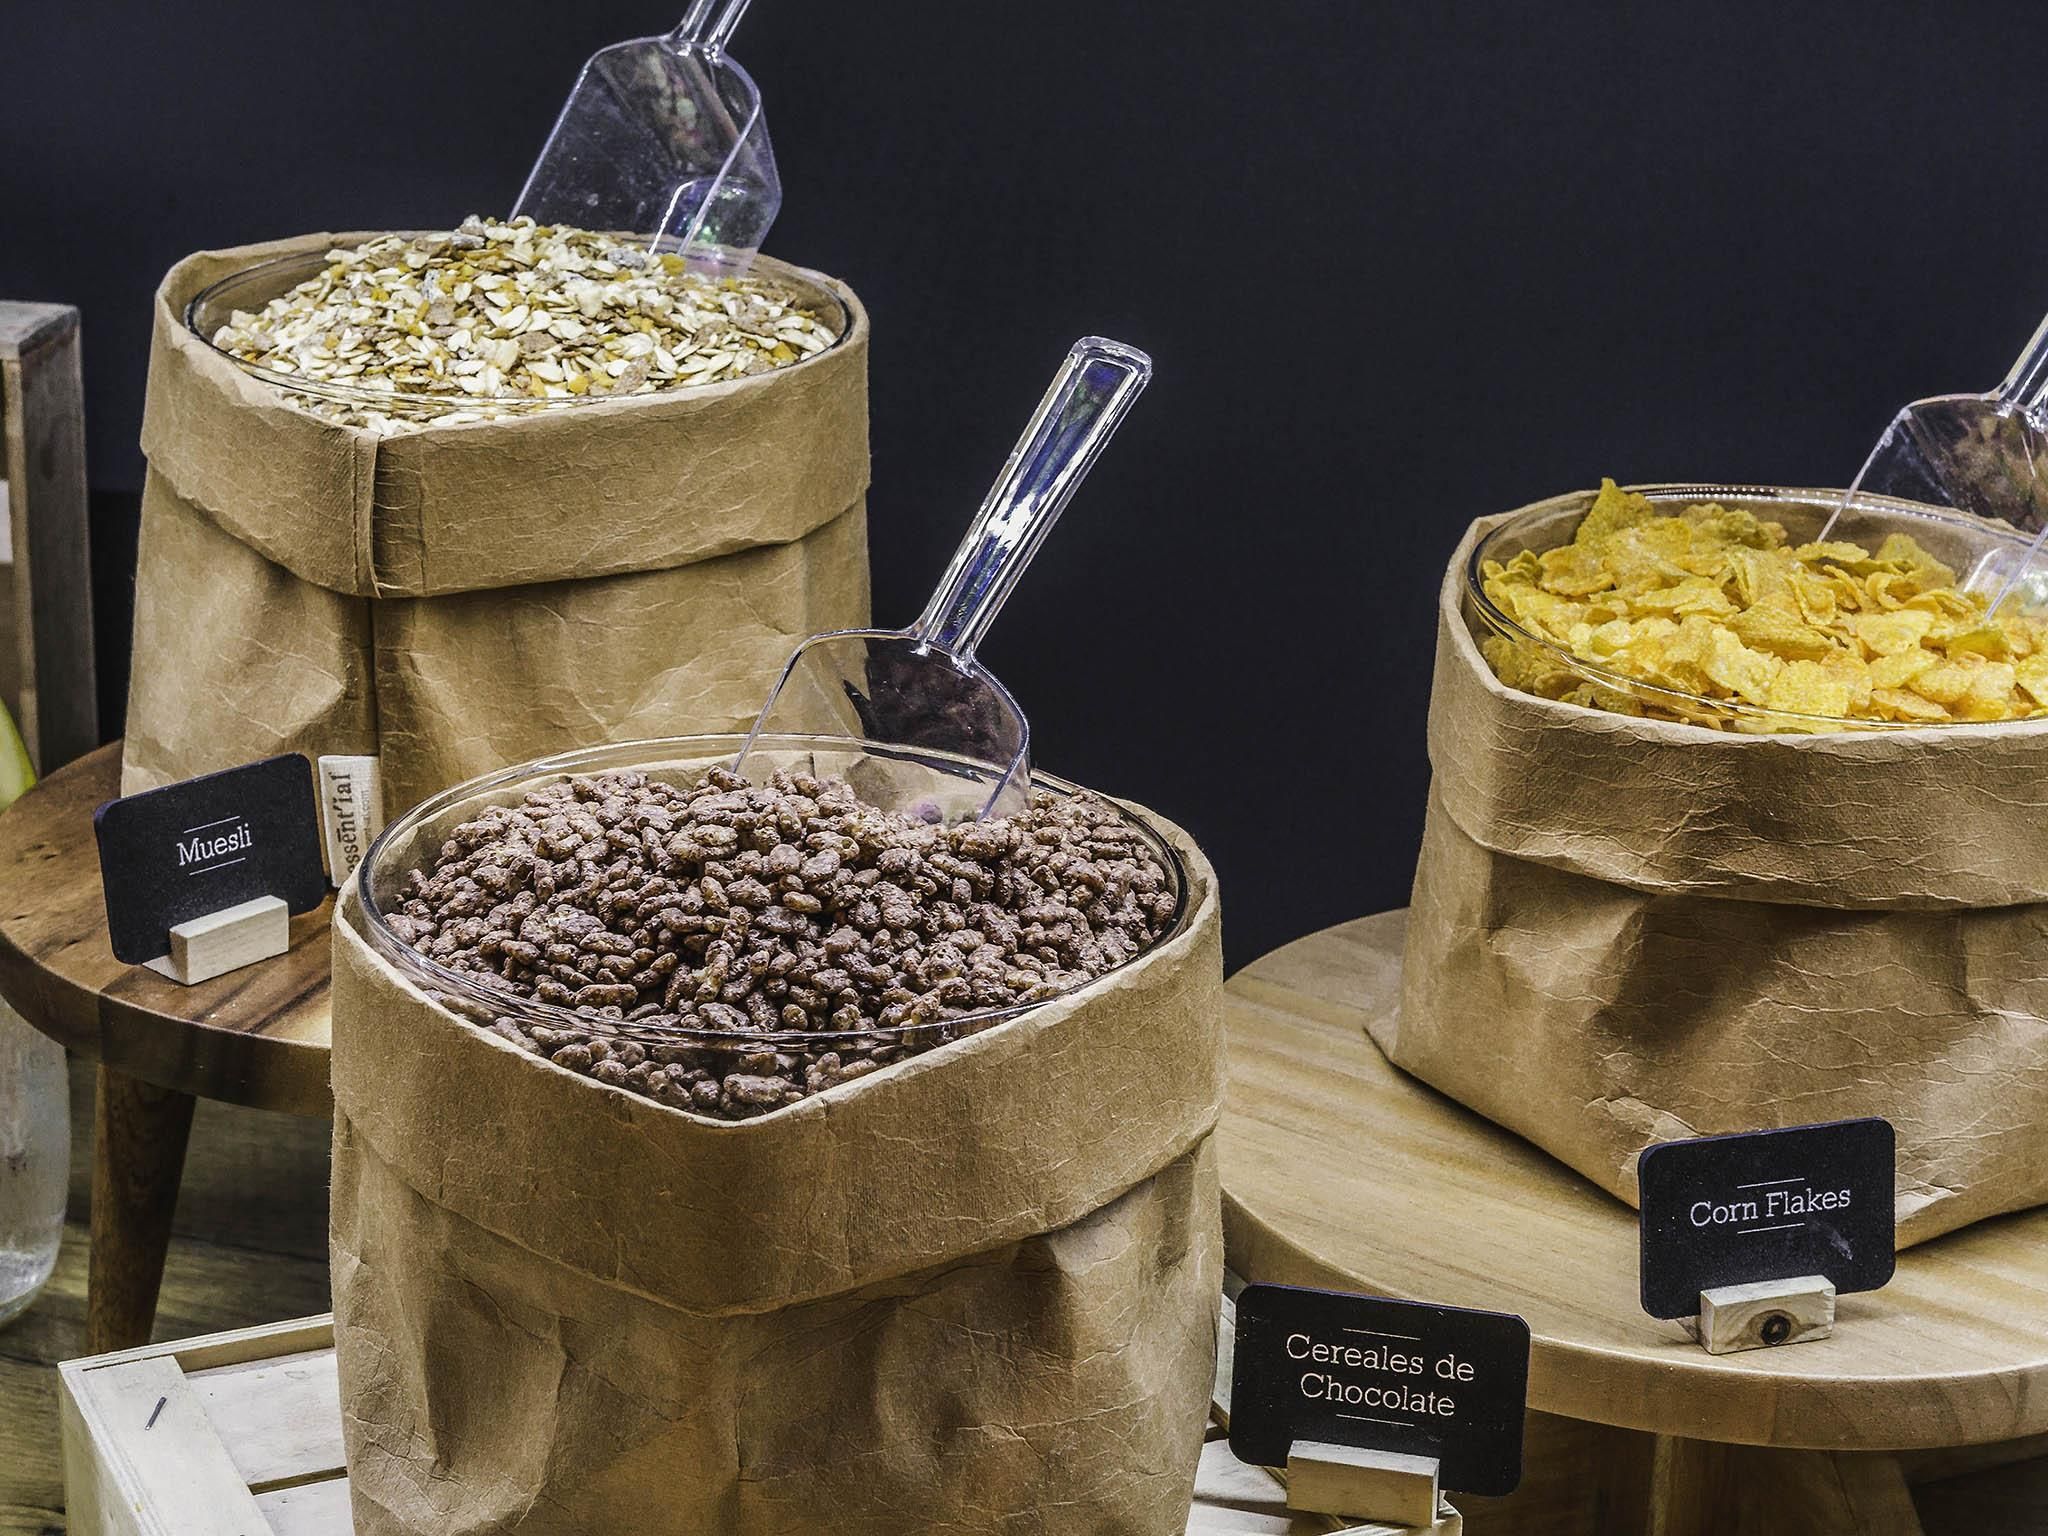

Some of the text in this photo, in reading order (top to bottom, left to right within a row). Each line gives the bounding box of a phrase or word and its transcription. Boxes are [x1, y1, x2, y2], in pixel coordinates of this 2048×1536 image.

[176, 823, 253, 866] Muesli
[1690, 1188, 1851, 1226] Corn Flakes
[1286, 1333, 1475, 1381] Cereales de
[1300, 1373, 1456, 1416] Chocolate
